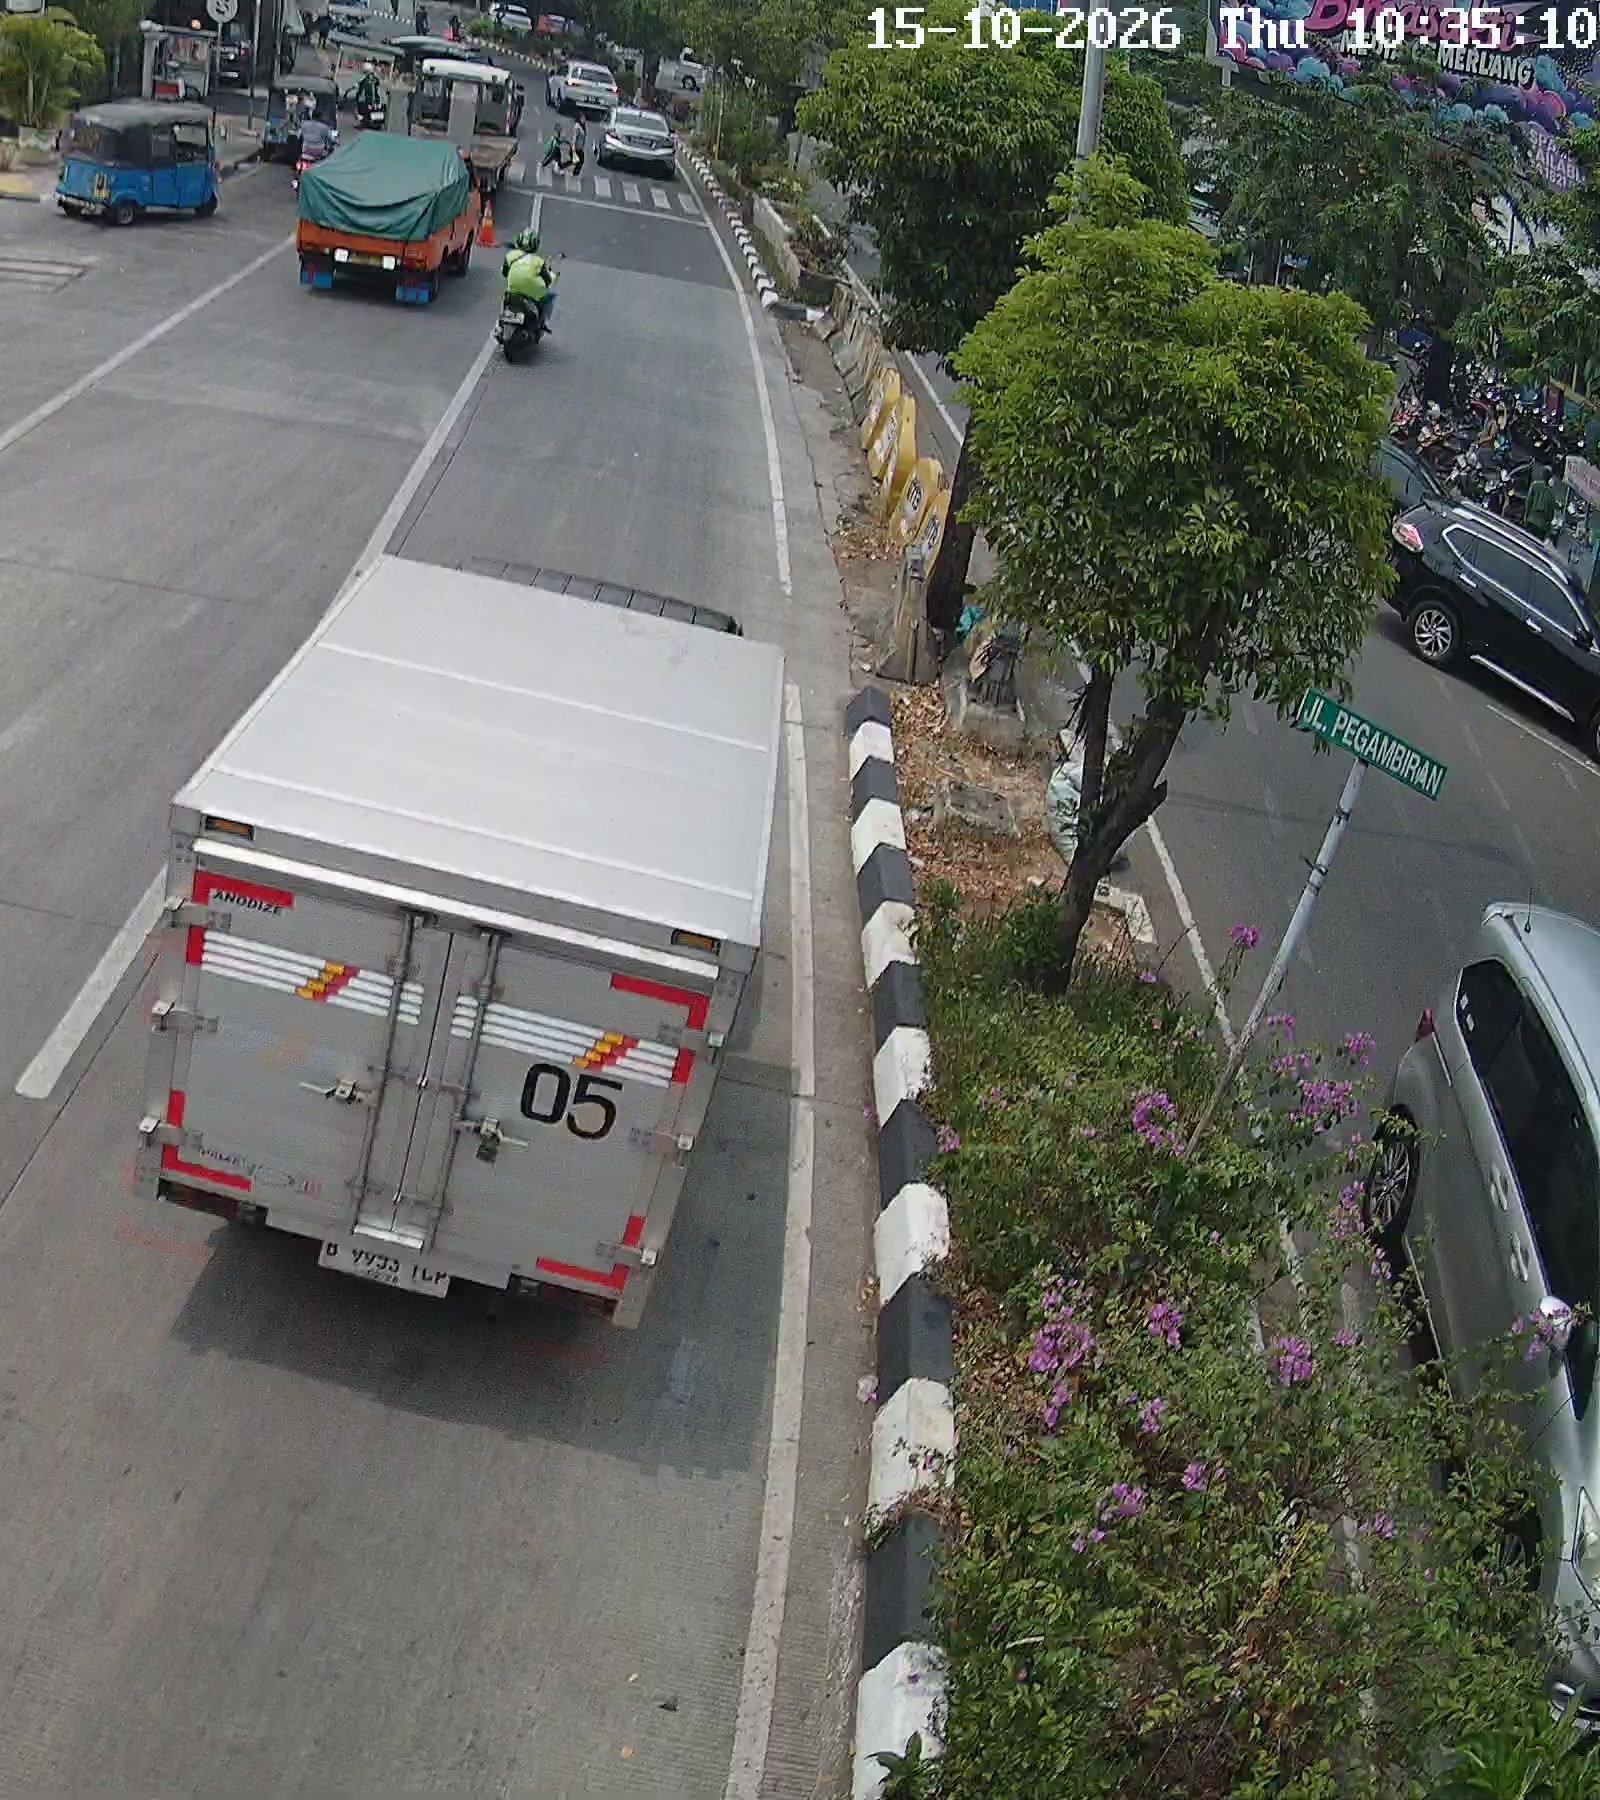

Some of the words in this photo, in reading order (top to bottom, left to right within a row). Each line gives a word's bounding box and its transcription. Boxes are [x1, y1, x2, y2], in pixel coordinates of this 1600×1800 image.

[1303, 695, 1327, 733] JL.
[1331, 710, 1443, 796] PEGAMBIRAN
[213, 889, 285, 915] ANODIZE
[520, 1063, 623, 1140] 05
